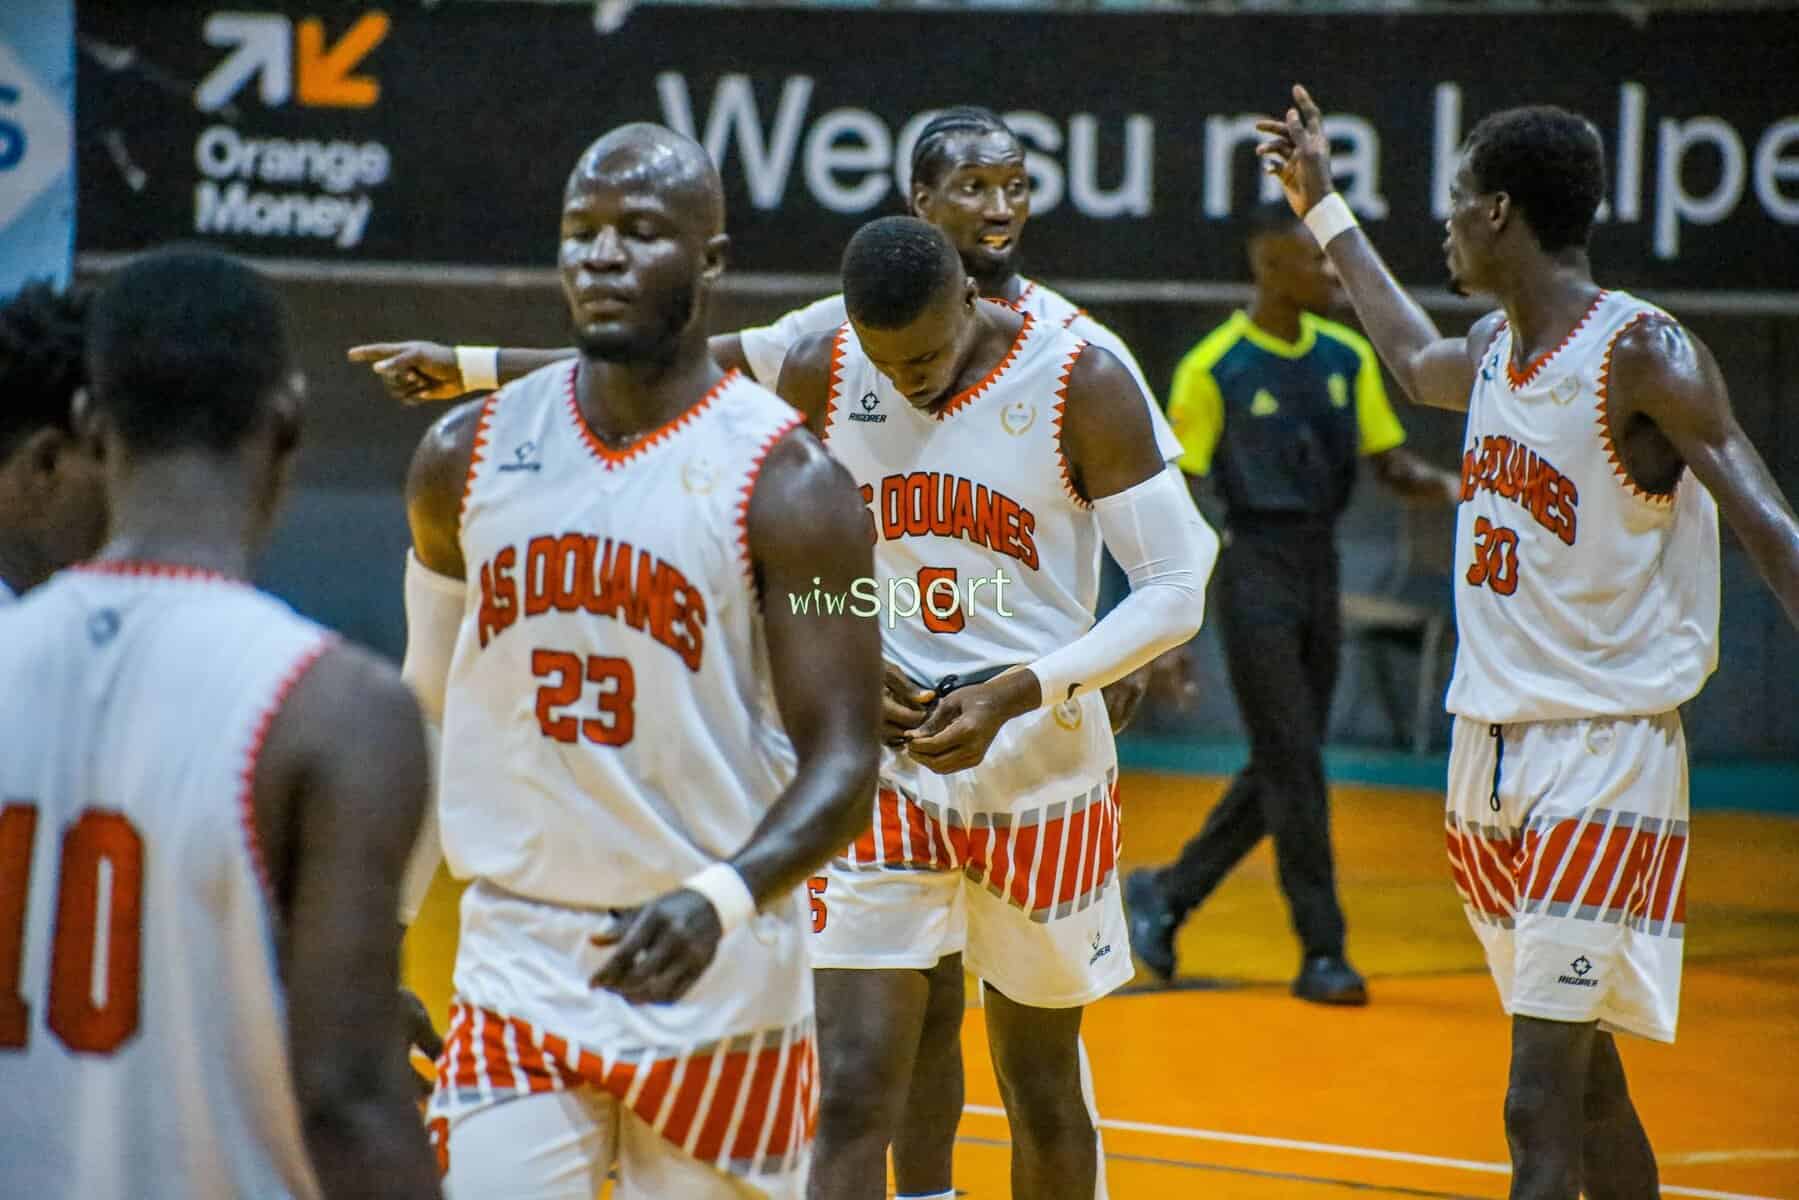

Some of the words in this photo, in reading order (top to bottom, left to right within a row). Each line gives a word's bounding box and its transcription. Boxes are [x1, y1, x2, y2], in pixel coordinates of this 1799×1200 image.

[195, 126, 388, 191] Orange
[195, 181, 372, 248] Money
[881, 471, 1040, 572] DOUANES
[1466, 516, 1520, 597] 30
[478, 545, 519, 650] AS
[524, 532, 708, 673] DOUANES
[531, 649, 636, 748] 23
[0, 803, 146, 1055] 10
